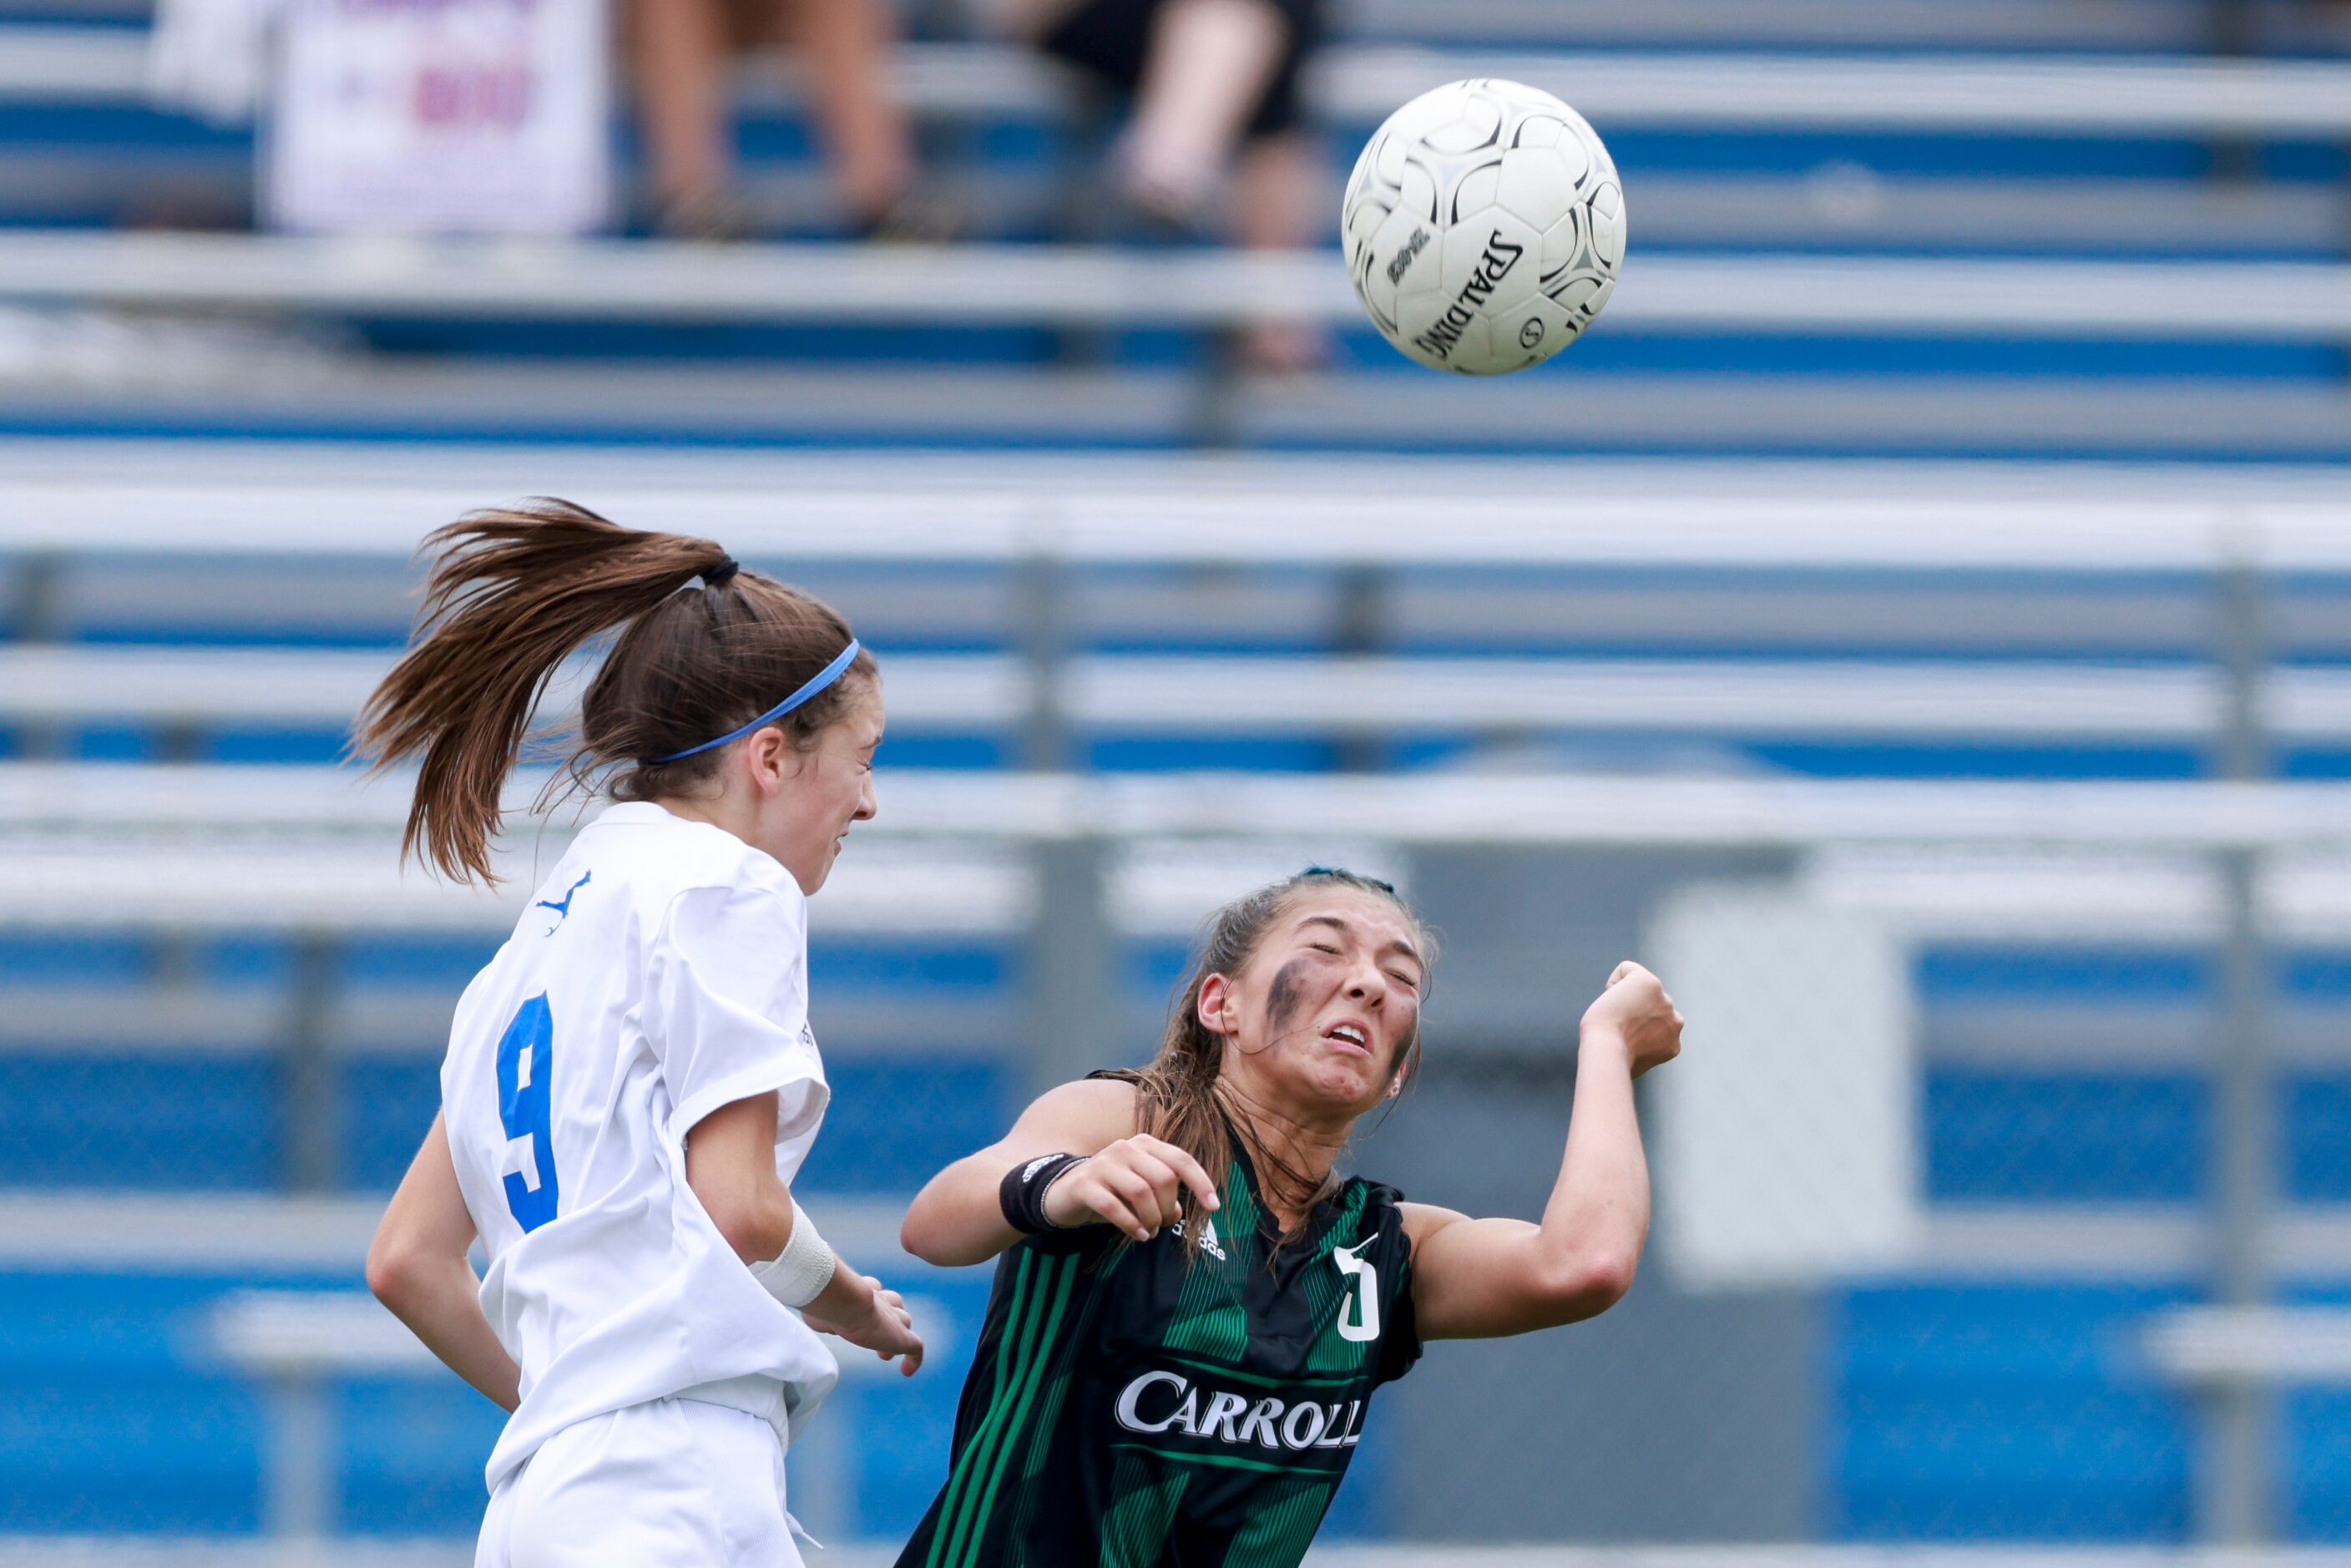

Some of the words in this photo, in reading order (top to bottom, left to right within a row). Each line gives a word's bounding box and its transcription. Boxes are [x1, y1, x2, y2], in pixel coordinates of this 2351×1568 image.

[1413, 228, 1524, 361] SPALDING
[496, 989, 559, 1235] 9
[1115, 1370, 1361, 1450] CARROLL
